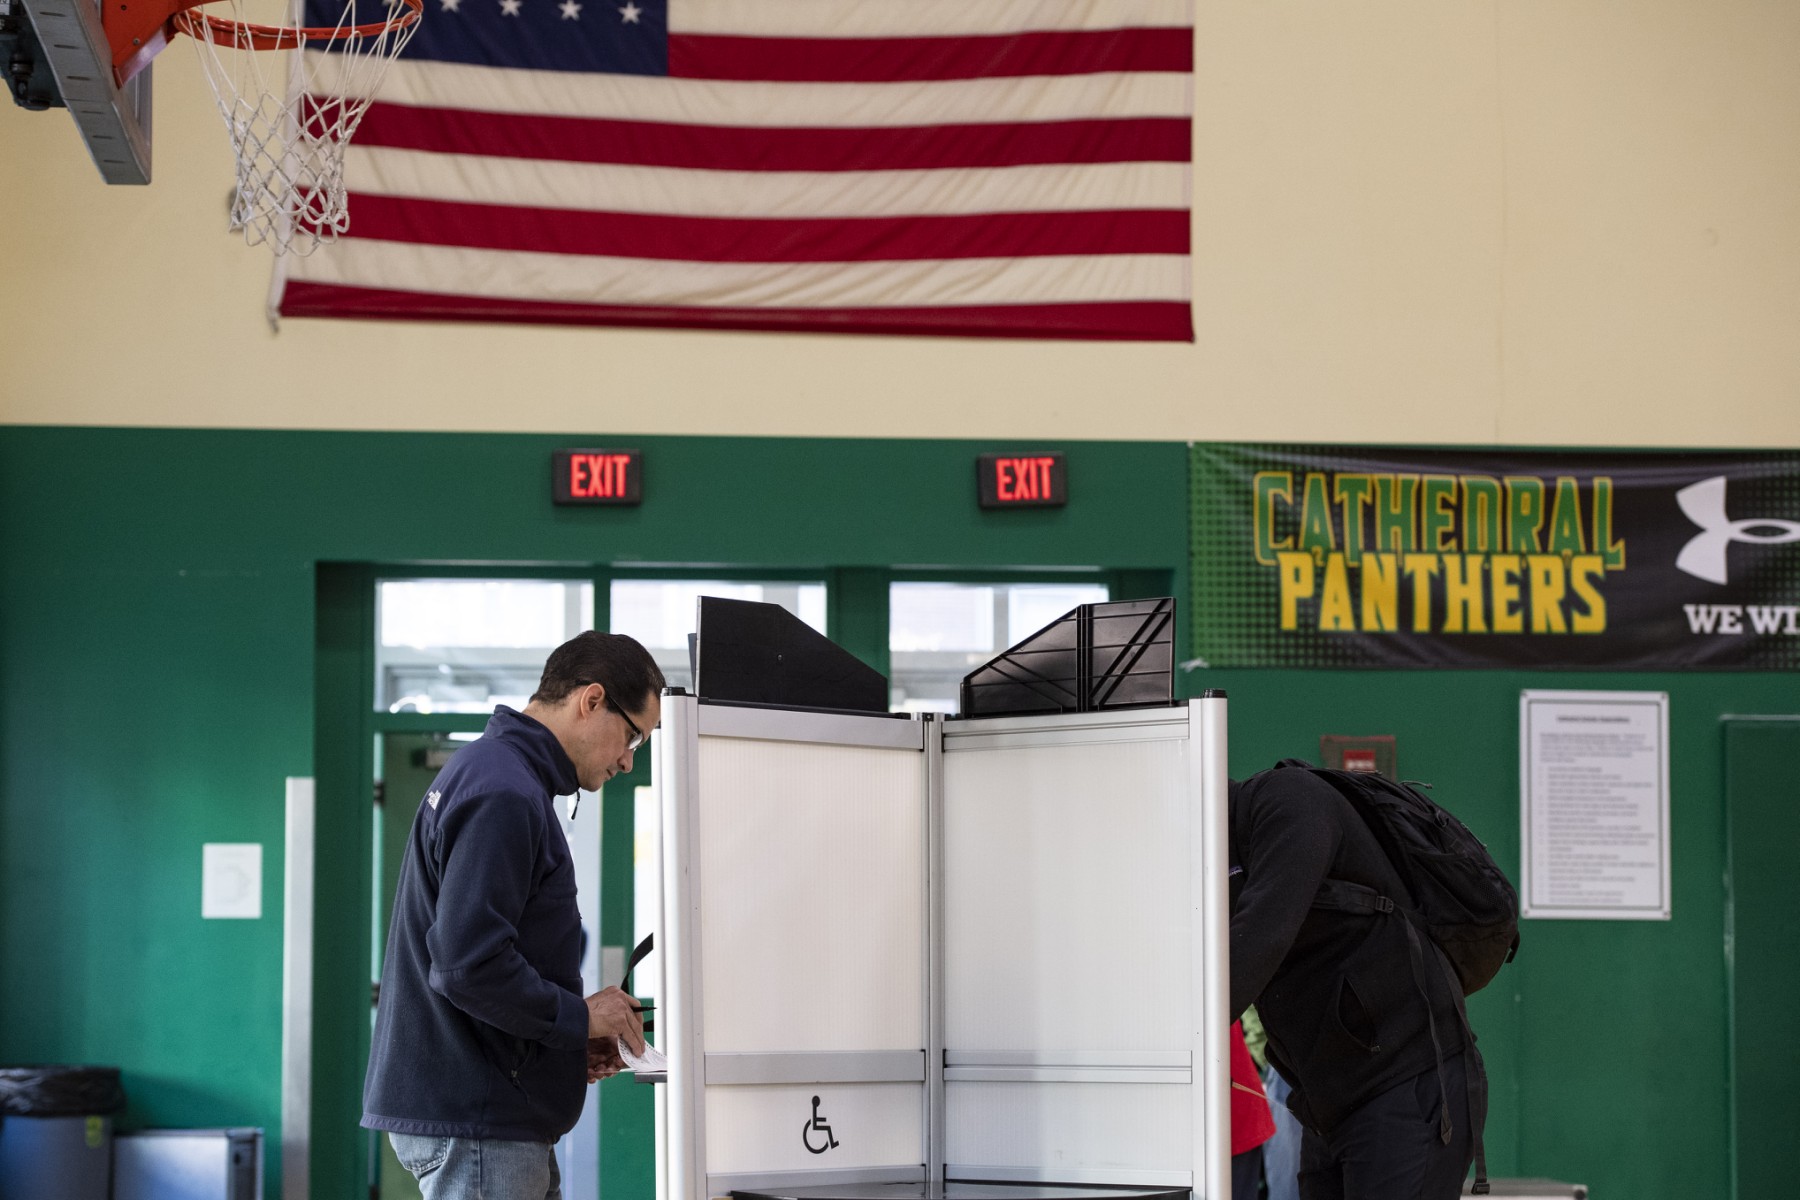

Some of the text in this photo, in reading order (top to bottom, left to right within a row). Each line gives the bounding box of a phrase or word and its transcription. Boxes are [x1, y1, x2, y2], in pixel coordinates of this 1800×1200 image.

[570, 454, 631, 498] EXIT
[995, 457, 1055, 501] EXIT
[1253, 471, 1626, 570] CATHEDRAL
[1277, 552, 1607, 634] PANTHERS
[1683, 604, 1743, 634] WE
